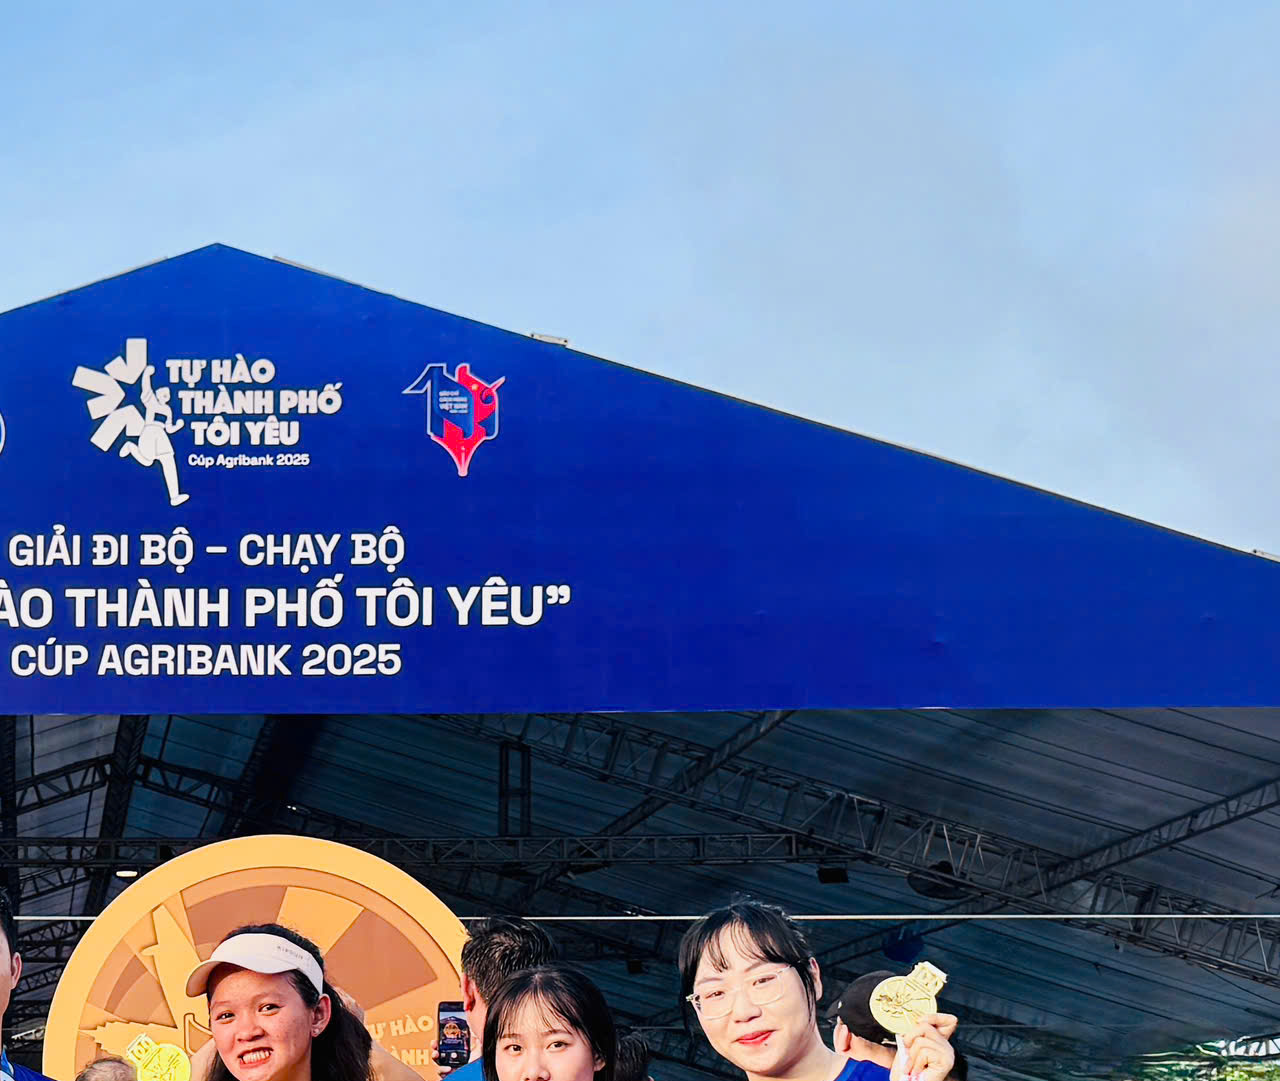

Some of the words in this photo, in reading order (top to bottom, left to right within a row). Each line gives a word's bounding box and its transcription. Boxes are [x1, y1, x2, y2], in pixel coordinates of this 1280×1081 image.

[165, 358, 207, 388] TỰ
[211, 353, 276, 384] HÀO
[178, 385, 275, 414] THÀNH
[279, 382, 343, 415] PHỐ
[190, 415, 241, 446] TÔI
[245, 415, 300, 446] YÊU
[188, 454, 214, 469] Cúp
[216, 453, 274, 469] Agribank
[276, 453, 310, 466] 2025
[8, 523, 81, 567] GIẢI
[91, 533, 129, 566] ĐI
[140, 525, 194, 573] BỘ
[239, 533, 342, 573] CHẠY
[351, 525, 405, 574] BỘ
[66, 578, 230, 628] THÀNH
[247, 572, 345, 627] PHỐ
[356, 575, 433, 627] TÔI
[448, 574, 571, 627] YÊU”
[10, 635, 89, 676] CÚP
[98, 643, 292, 676] AGRIBANK
[301, 643, 402, 676] 2025
[390, 1013, 435, 1037] HÀO
[391, 1045, 429, 1066] ÀNH
